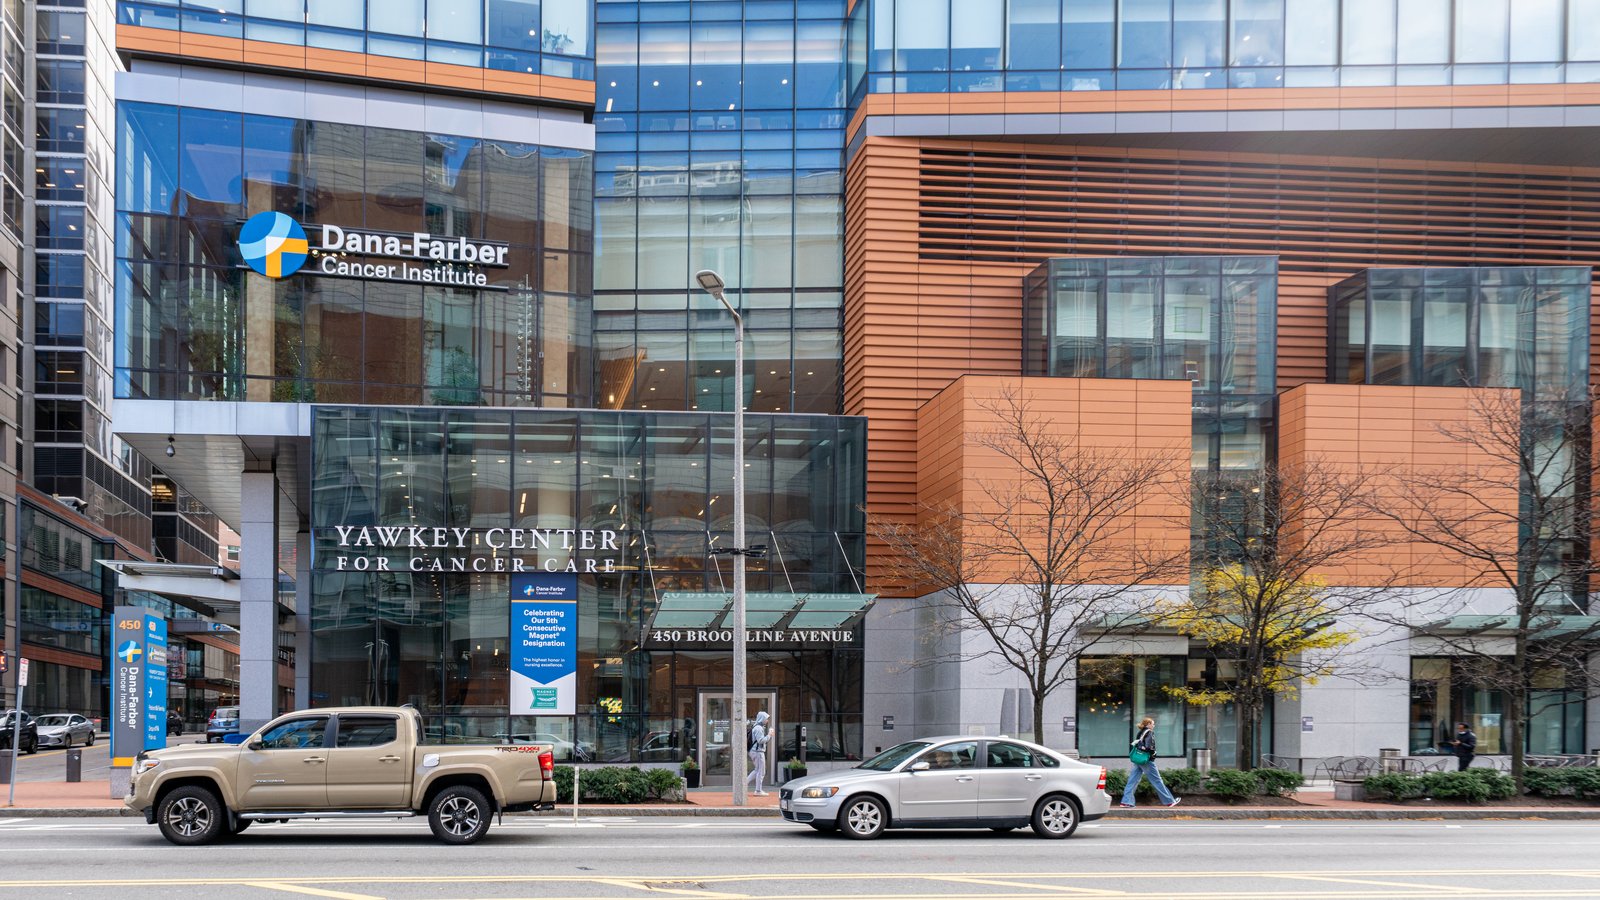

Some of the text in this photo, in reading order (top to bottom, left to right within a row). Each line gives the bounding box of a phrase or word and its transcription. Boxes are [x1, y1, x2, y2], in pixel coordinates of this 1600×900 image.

[322, 223, 509, 265] Dana-Farber
[321, 255, 488, 286] Cancer Institute
[335, 525, 619, 550] YAWKEY CENTER
[336, 556, 616, 573] FOR CANCER CARE
[523, 609, 565, 617] Celebrating
[118, 620, 141, 630] 450
[523, 640, 565, 648] Designation
[653, 630, 853, 642] 450 BROOLINE AVENUE
[120, 667, 128, 723] Cancer Institute
[128, 667, 139, 729] Dana-Farber
